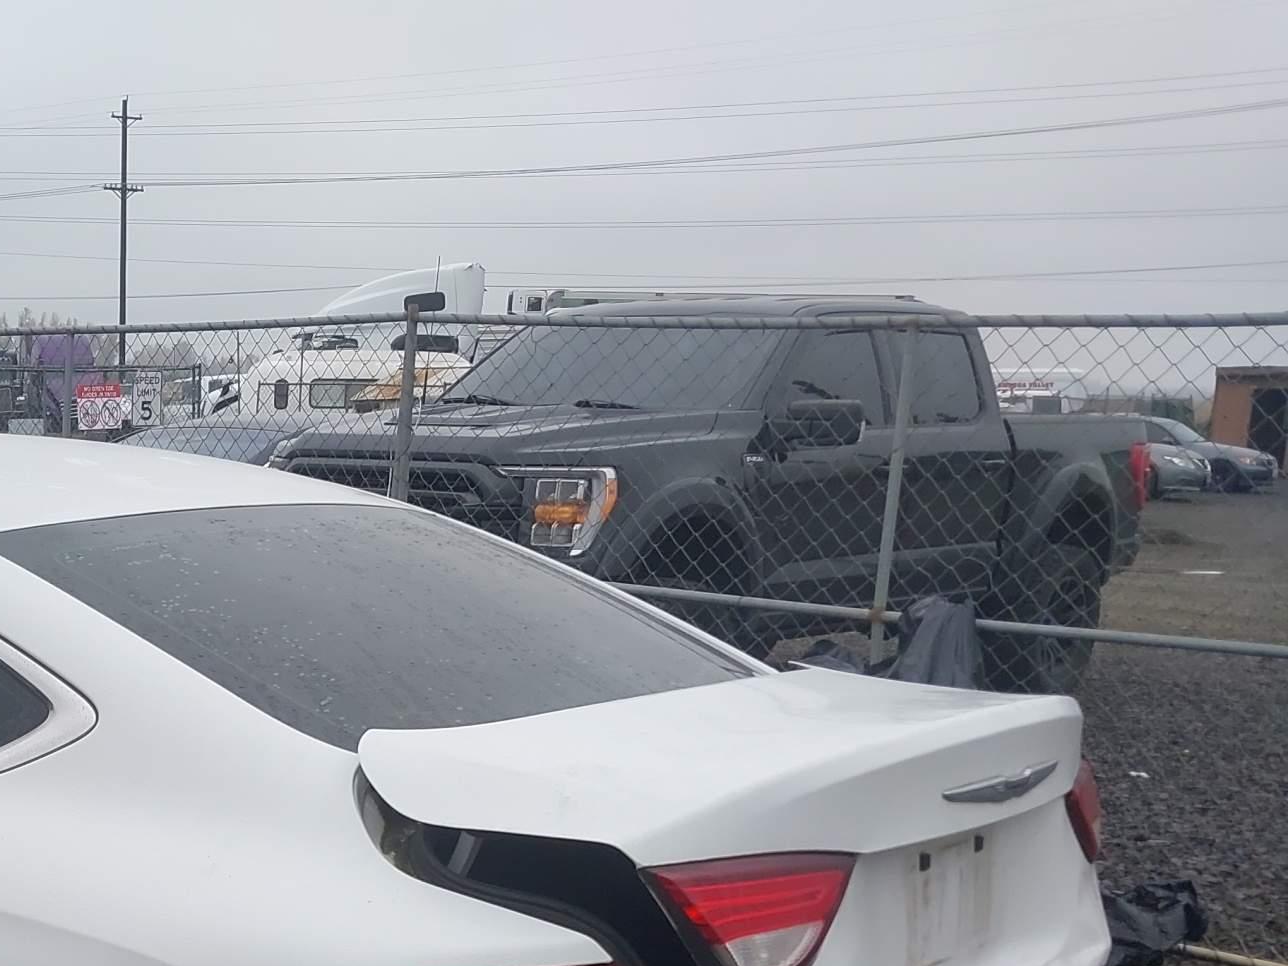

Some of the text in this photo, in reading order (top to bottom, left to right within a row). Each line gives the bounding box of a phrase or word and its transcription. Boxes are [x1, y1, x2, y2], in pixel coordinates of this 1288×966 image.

[135, 377, 159, 385] SPEED
[136, 388, 157, 398] LIMIT
[141, 401, 152, 420] 5
